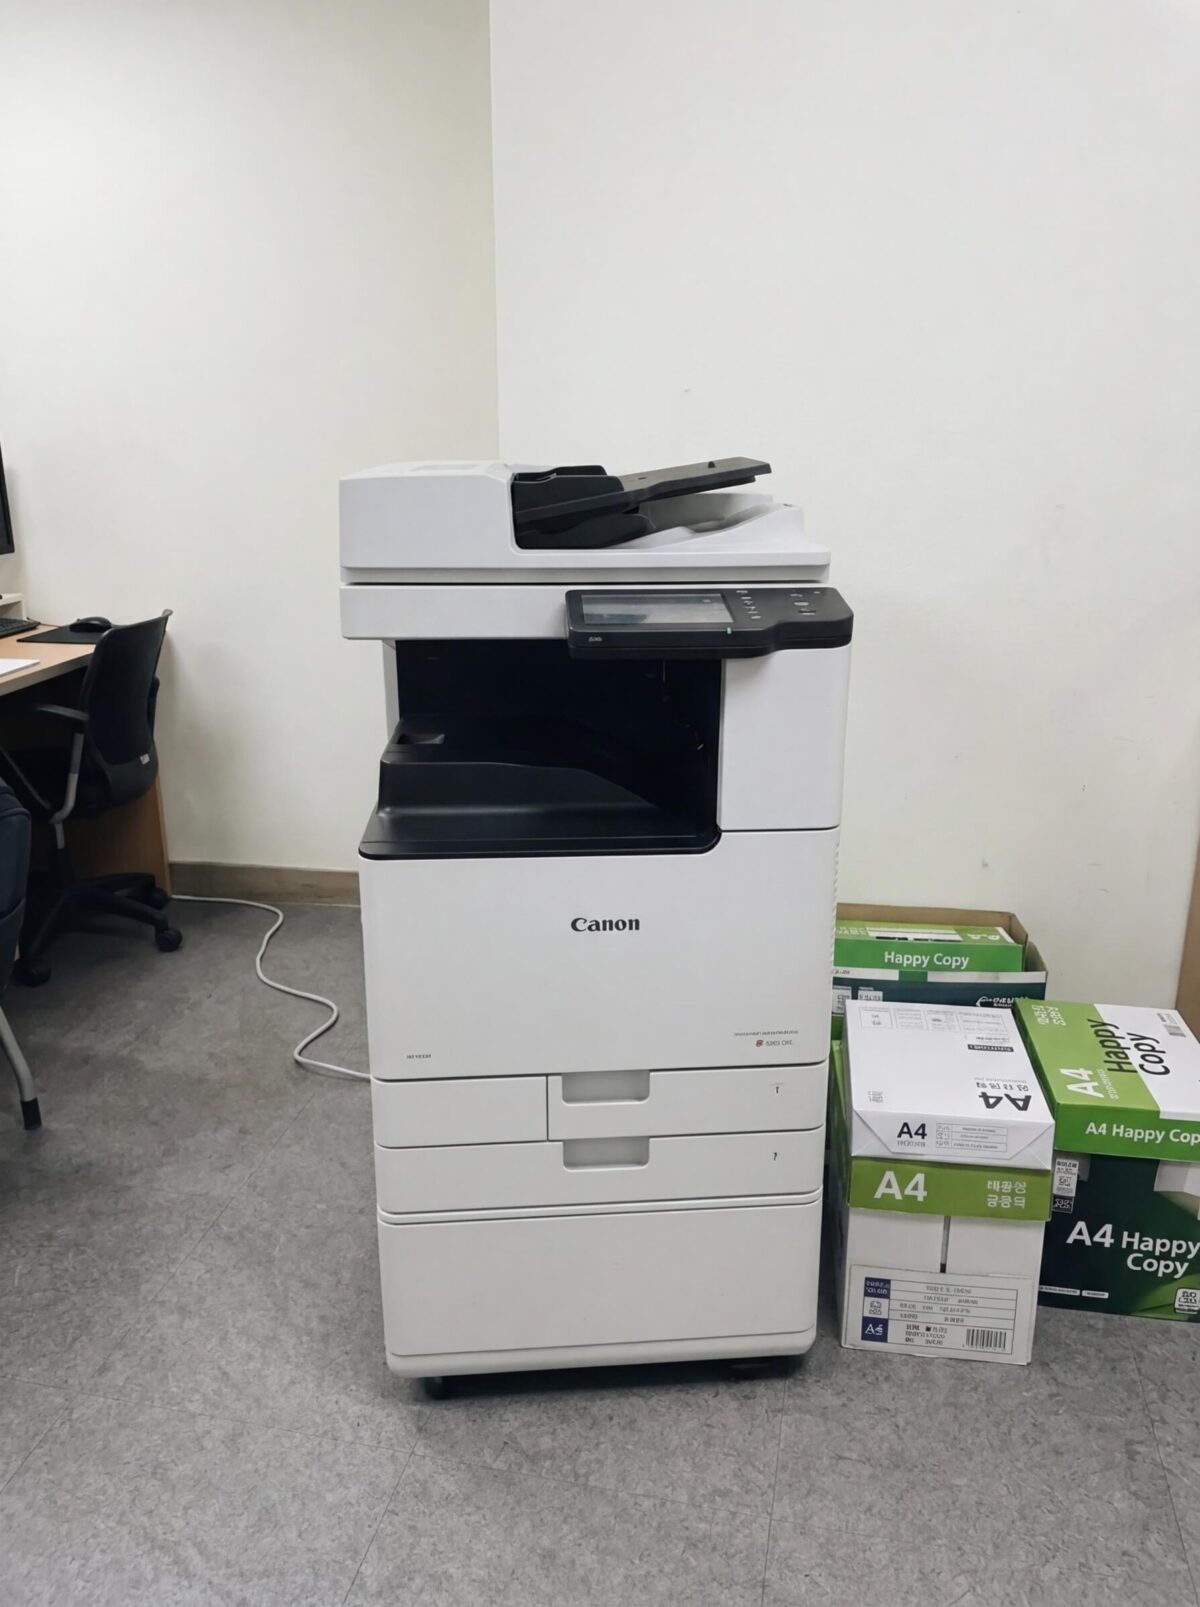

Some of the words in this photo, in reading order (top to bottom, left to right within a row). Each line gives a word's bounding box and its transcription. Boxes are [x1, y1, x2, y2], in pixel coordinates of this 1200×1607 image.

[571, 917, 640, 932] Canon
[884, 951, 930, 968] Happy
[933, 953, 970, 969] Copy
[1087, 1019, 1138, 1073] Happy
[1127, 1032, 1170, 1076] Copy
[1059, 1067, 1105, 1098] A4
[978, 1091, 1032, 1111] A4
[897, 1122, 927, 1139] A4
[1085, 1122, 1107, 1135] A4
[1112, 1123, 1165, 1143] Happy
[873, 1170, 928, 1202] A4
[1066, 1220, 1114, 1248] A4
[1121, 1231, 1200, 1259] Happy
[1126, 1253, 1189, 1279] Copy
